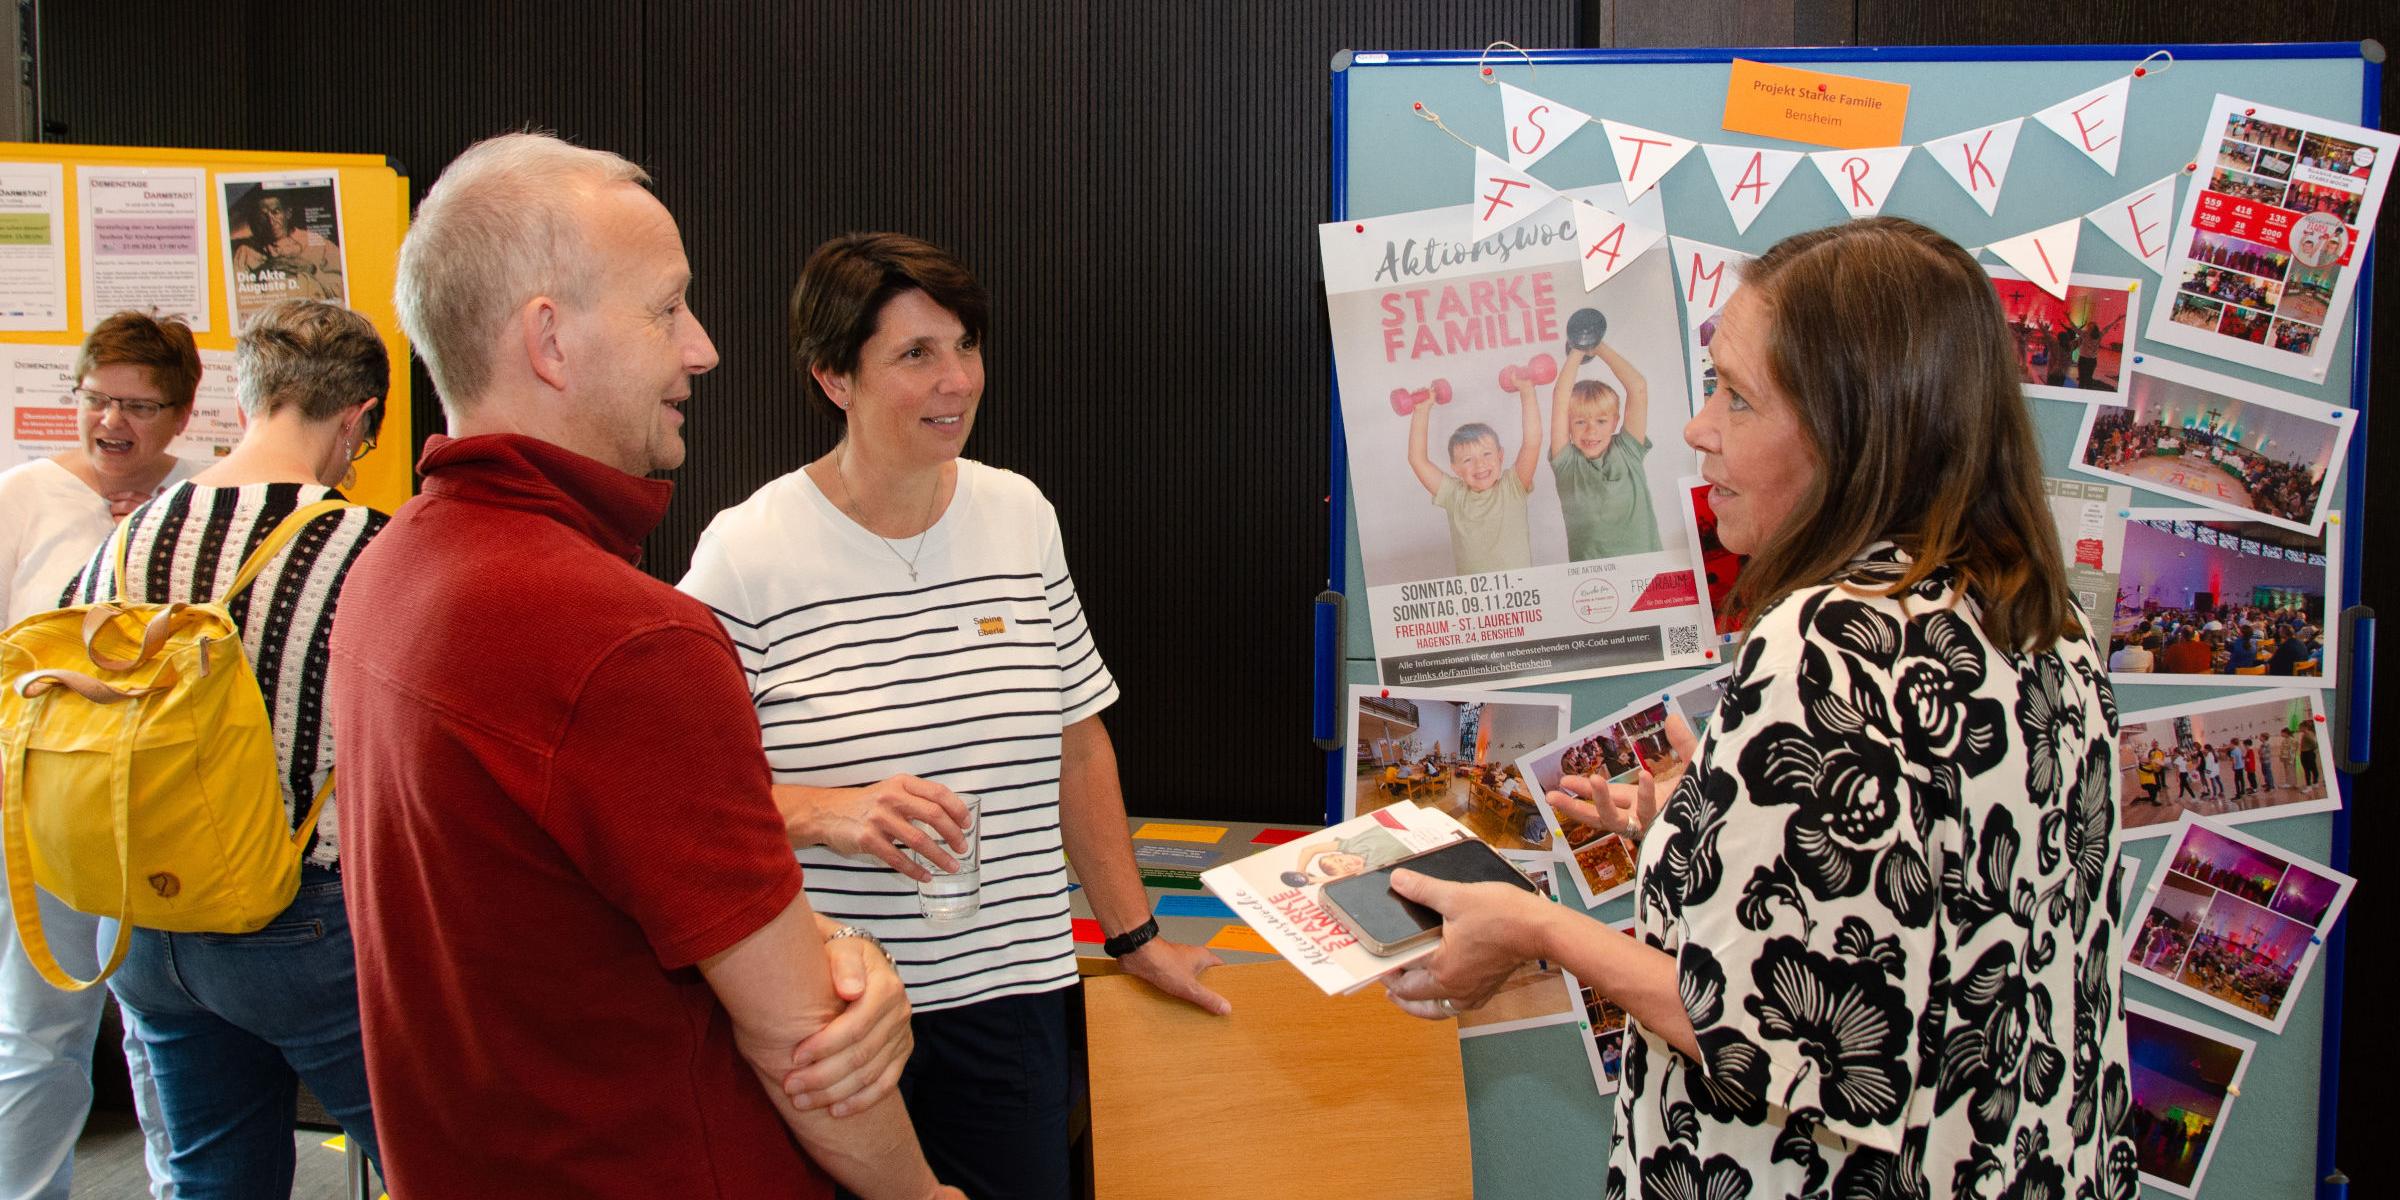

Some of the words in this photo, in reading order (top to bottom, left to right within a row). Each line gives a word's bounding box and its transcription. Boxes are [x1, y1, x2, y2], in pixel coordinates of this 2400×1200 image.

[1753, 80, 1796, 98] Projekt
[1798, 86, 1836, 104] Starke
[1839, 94, 1883, 110] Familie
[1785, 108, 1842, 127] Bensheim
[1374, 217, 1578, 283] Aktionswoc
[237, 271, 256, 282] Die
[258, 269, 286, 281] Akte
[238, 280, 287, 293] Auguste
[288, 279, 300, 290] D.
[1381, 271, 1557, 328] STARKE
[1383, 307, 1560, 363] FAMILIE
[201, 409, 220, 417] mit!
[1567, 567, 1580, 576] EINE
[1603, 563, 1616, 573] VON
[1401, 579, 1467, 601] SONNTAG,
[1470, 573, 1514, 593] 02.11.
[1393, 599, 1459, 622] SONNTAG,
[1462, 589, 1541, 613] 09.11.2025
[973, 615, 1002, 625] Sabine
[1395, 620, 1449, 638] FREIRAUM
[1459, 617, 1476, 631] ST.
[1478, 609, 1543, 629] LAURENTIUS
[1399, 661, 1414, 670] Alle
[1415, 655, 1470, 668] Informationen
[1471, 652, 1489, 662] über
[1490, 650, 1505, 659] den
[1507, 643, 1570, 657] nebenstehenden
[1571, 639, 1609, 650] QR-Code
[1610, 635, 1625, 645] und
[1627, 633, 1650, 643] unter:
[1417, 634, 1463, 649] HAGENSTR.
[1481, 627, 1525, 641] BENSHEIM
[1399, 658, 1552, 683] kurzlinks.de/FamilienkircheBensheim
[1268, 892, 1335, 953] STARKE
